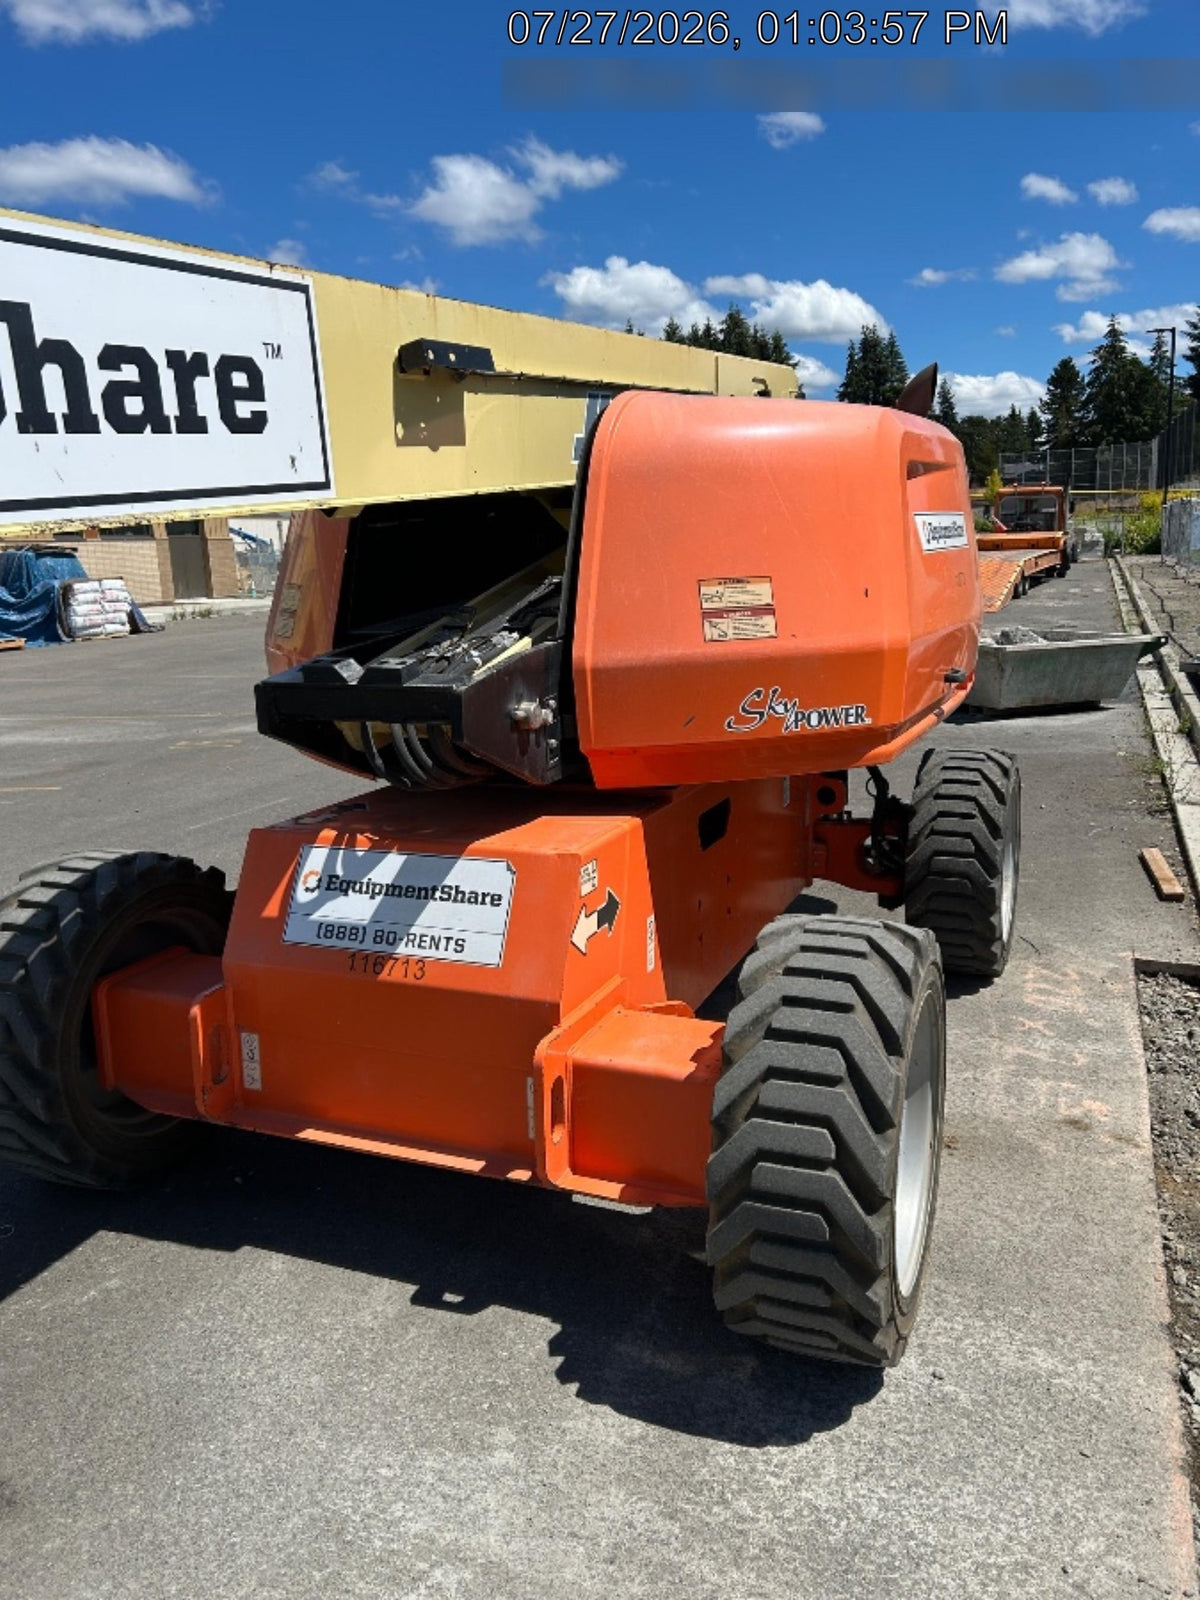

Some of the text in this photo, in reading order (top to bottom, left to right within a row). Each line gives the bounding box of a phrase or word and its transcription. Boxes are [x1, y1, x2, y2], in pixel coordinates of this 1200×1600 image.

[0, 300, 268, 434] hare
[325, 874, 502, 907] EquipmentShare
[316, 922, 466, 954] (888) 80-RENTS
[348, 953, 427, 981] 116713
